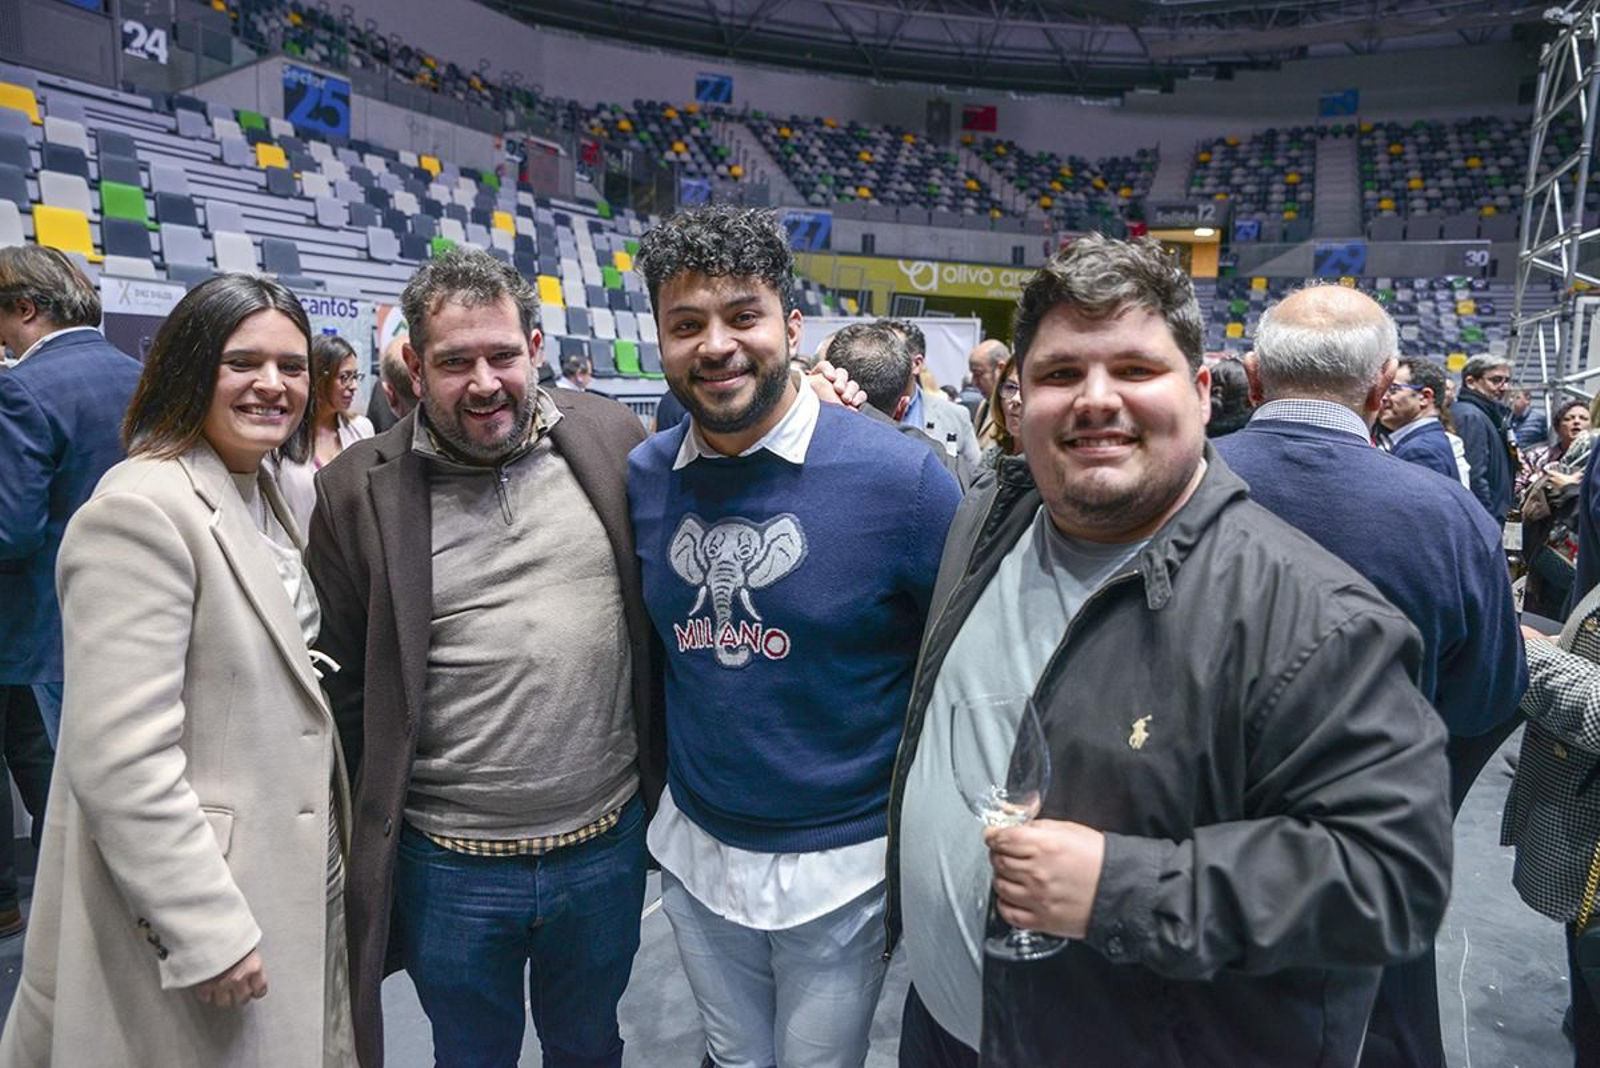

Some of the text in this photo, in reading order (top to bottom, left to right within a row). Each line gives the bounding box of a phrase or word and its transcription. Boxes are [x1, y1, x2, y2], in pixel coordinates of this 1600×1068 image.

[123, 20, 168, 65] 24
[284, 77, 350, 137] 25
[1197, 203, 1216, 221] 12
[783, 213, 832, 251] 27
[942, 264, 995, 287] olivo
[1464, 250, 1490, 267] 30
[674, 616, 791, 660] MILANO
